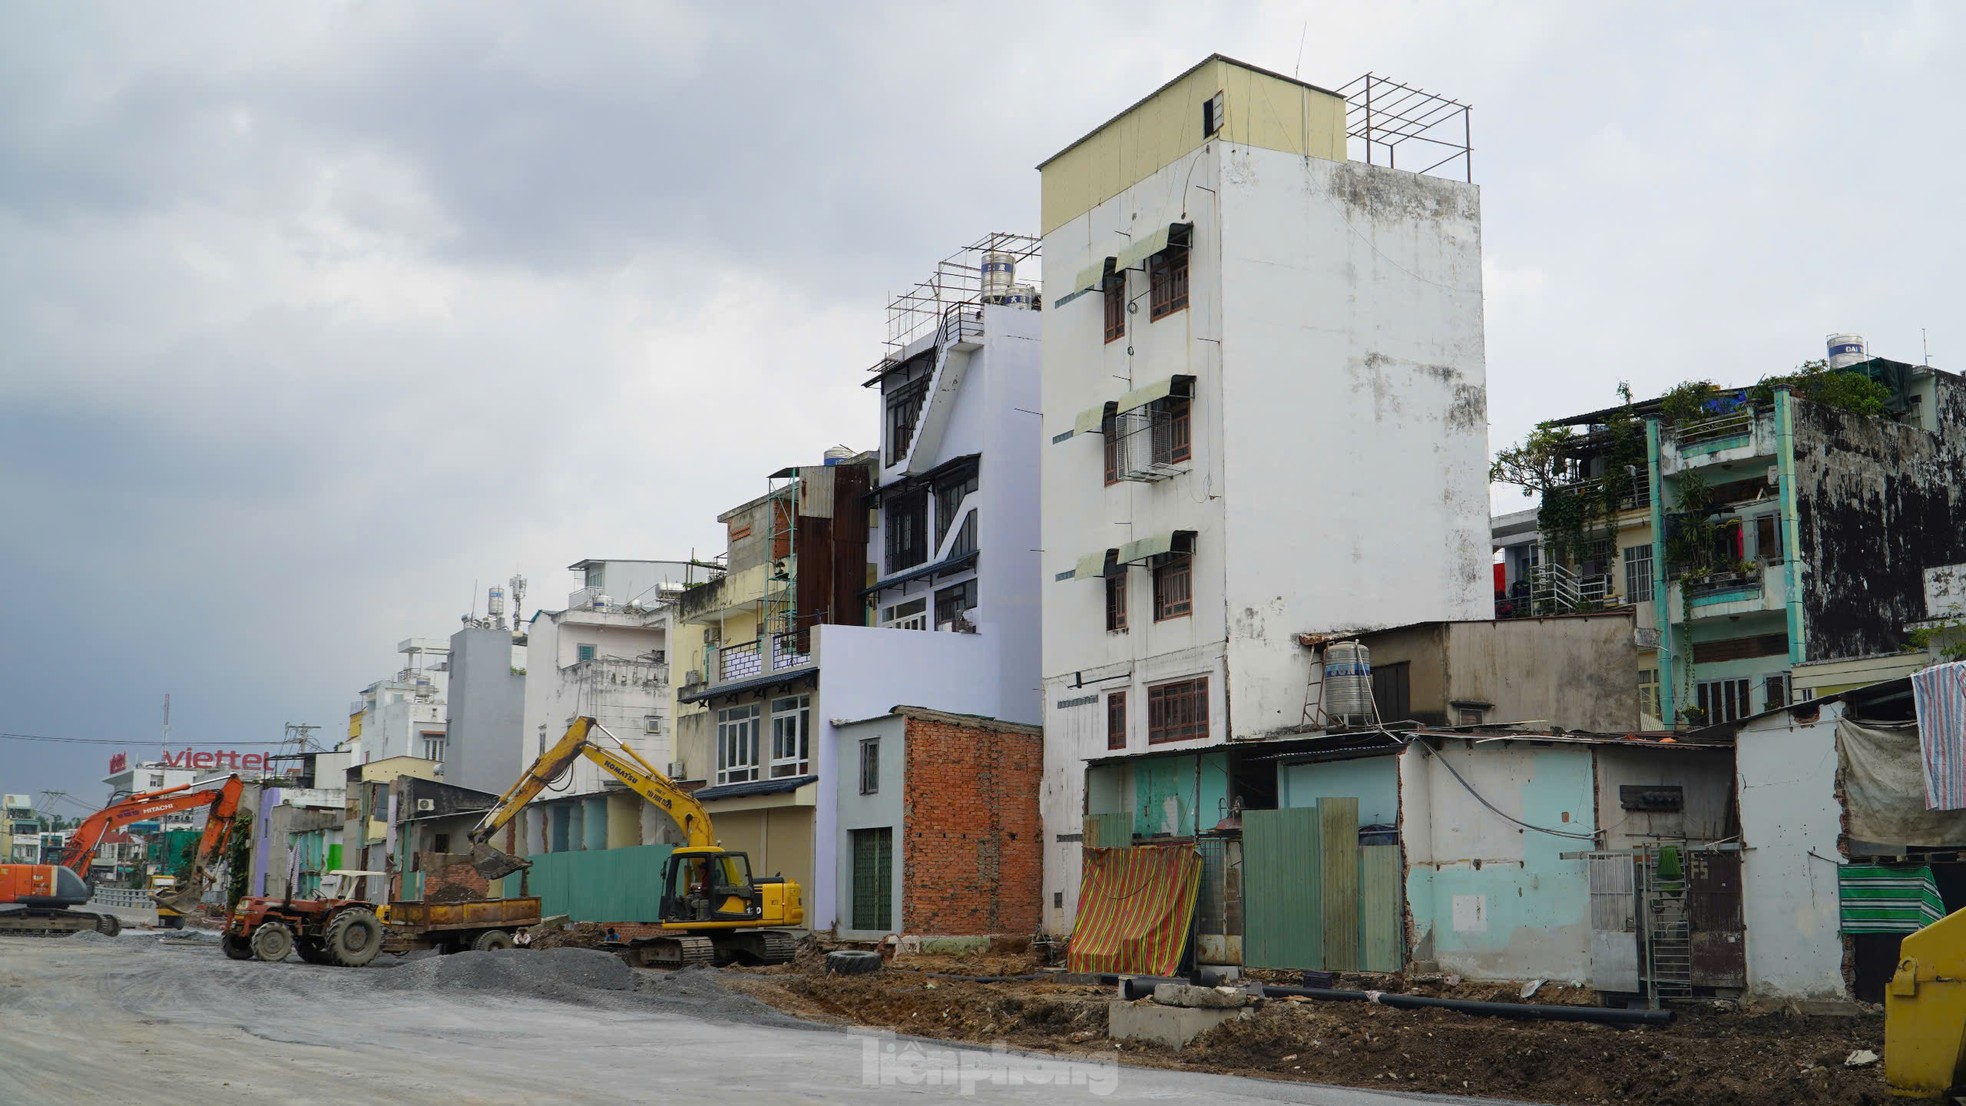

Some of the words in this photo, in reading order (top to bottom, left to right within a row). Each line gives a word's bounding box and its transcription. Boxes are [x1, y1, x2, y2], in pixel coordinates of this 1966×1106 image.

[163, 747, 274, 771] viettel
[604, 760, 638, 784] KOMATSU
[143, 803, 174, 814] HITACHI
